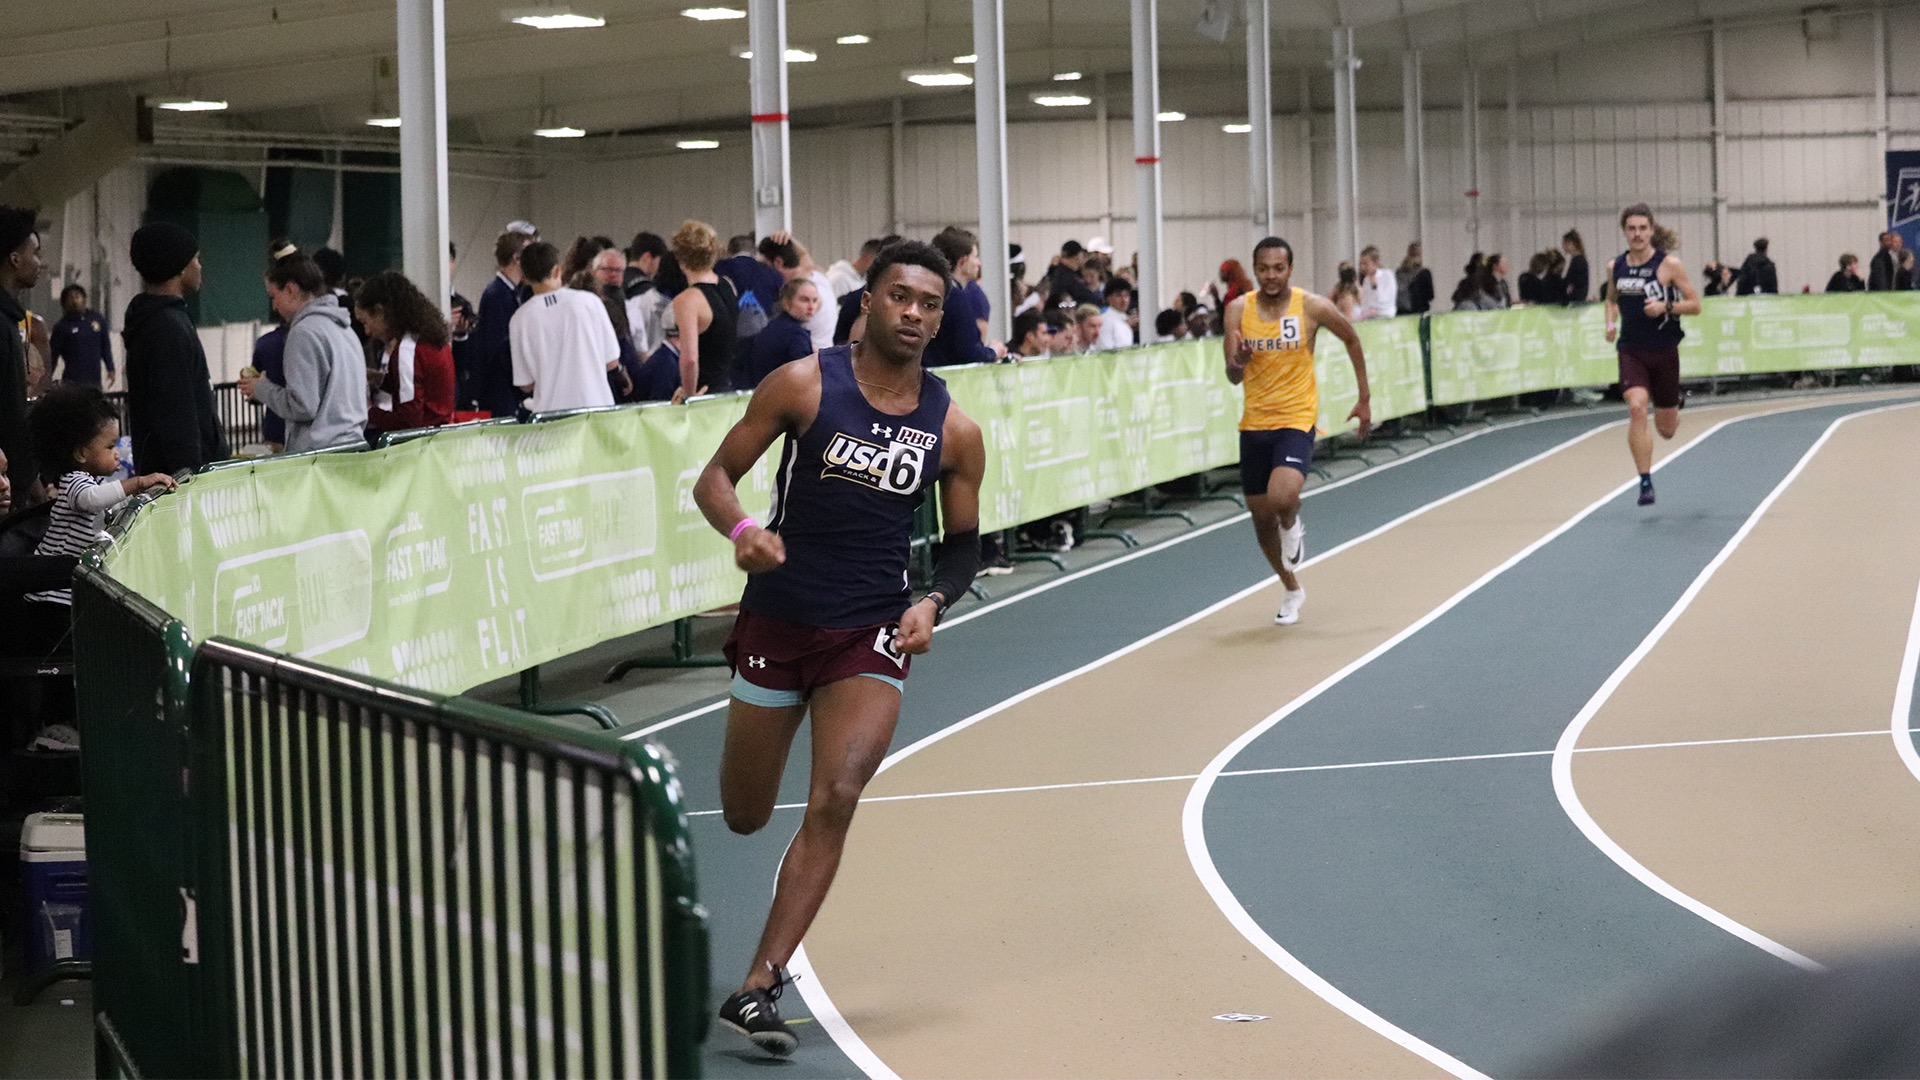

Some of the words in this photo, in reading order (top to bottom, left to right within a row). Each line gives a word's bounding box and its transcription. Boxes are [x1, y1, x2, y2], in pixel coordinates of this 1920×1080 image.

[1283, 318, 1297, 340] 5
[896, 426, 938, 450] PBC
[843, 469, 869, 480] TRACK
[888, 447, 919, 491] 6
